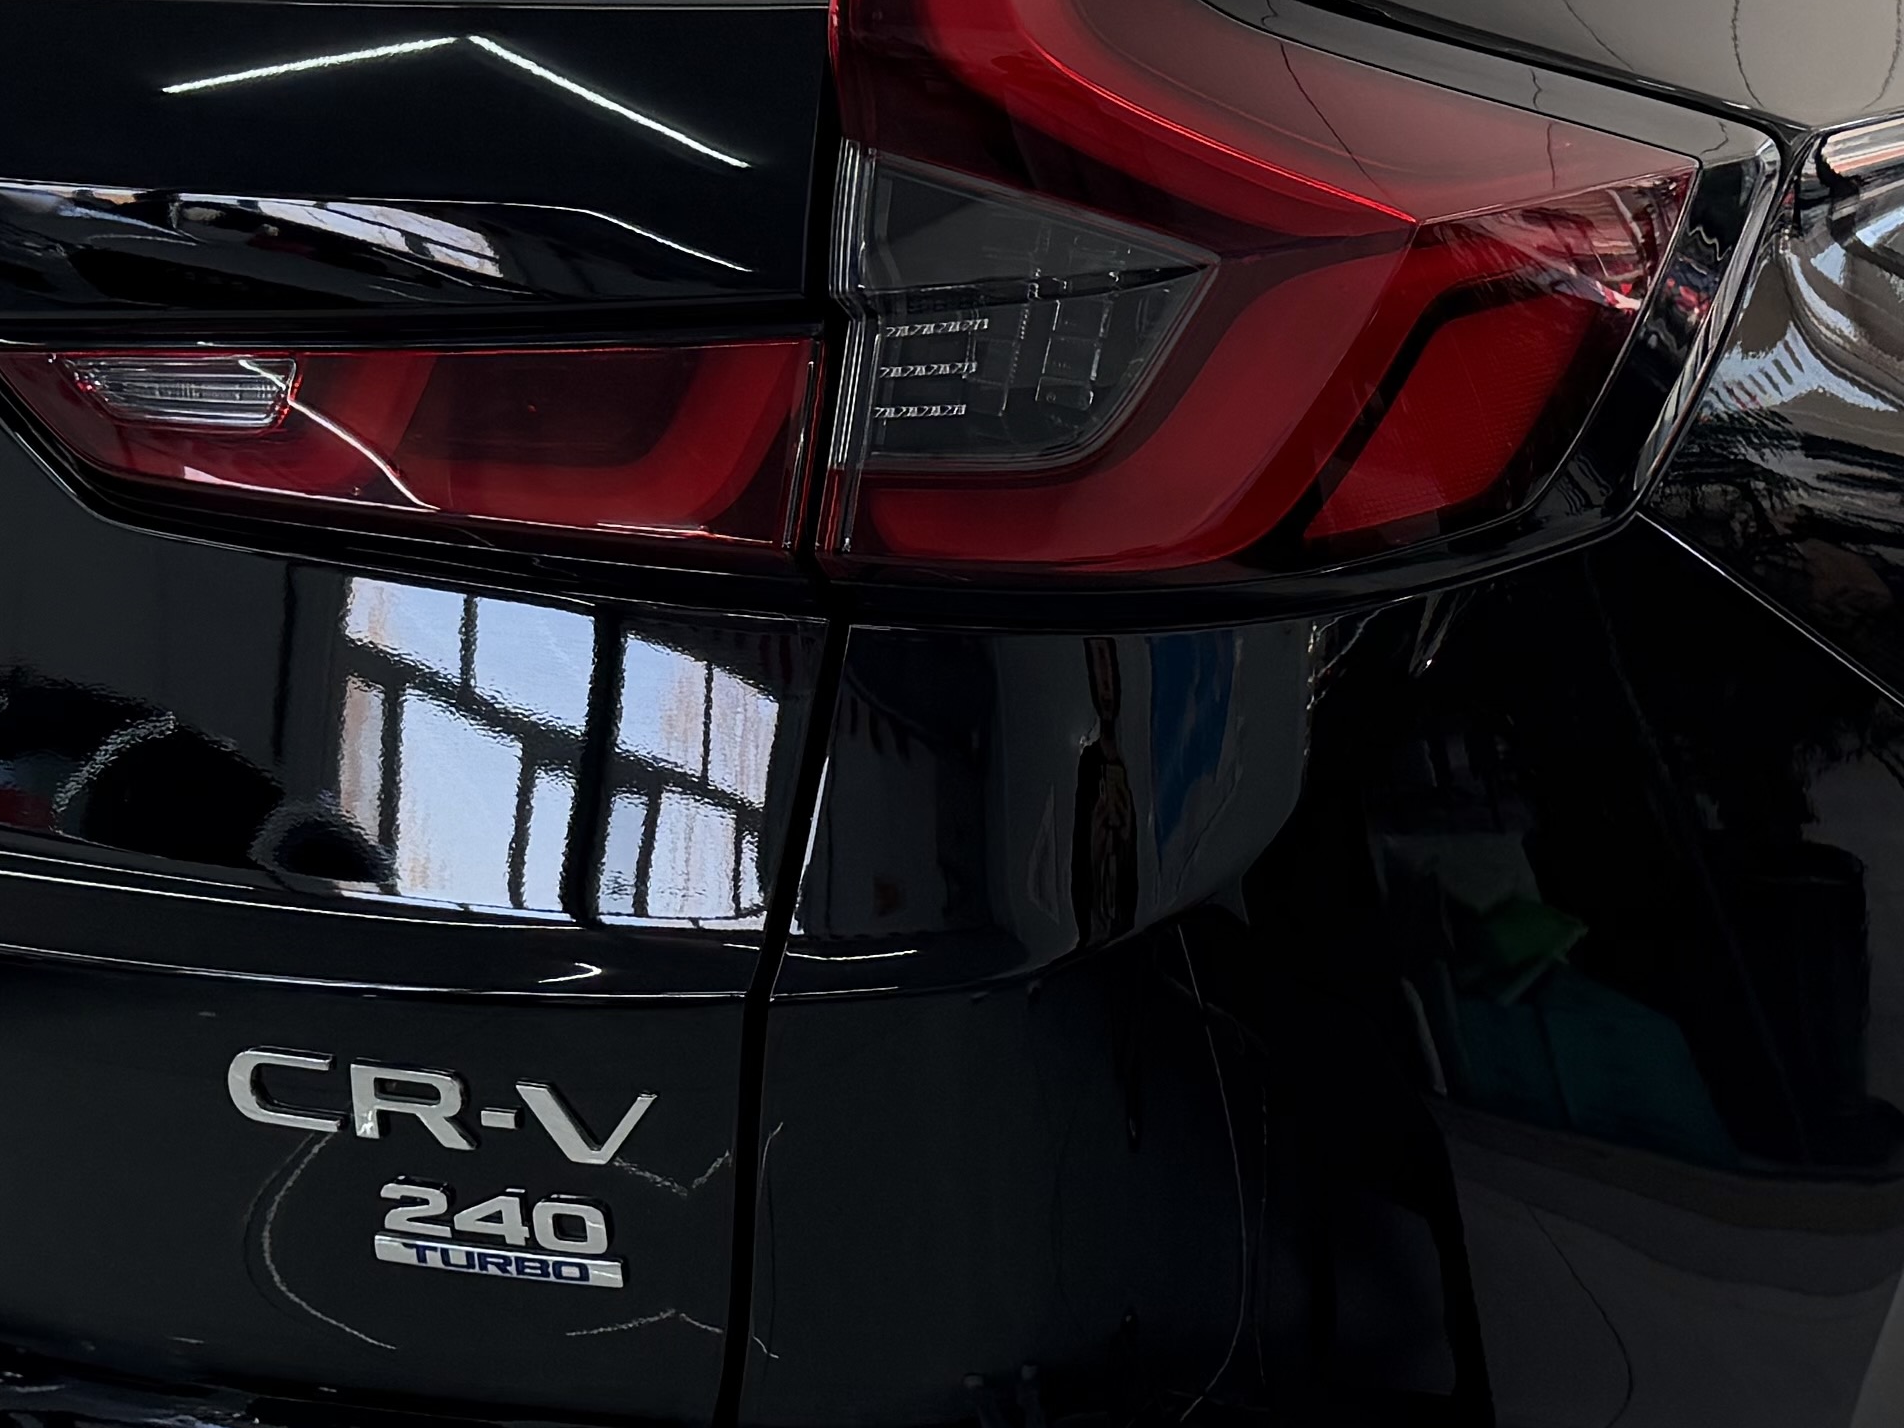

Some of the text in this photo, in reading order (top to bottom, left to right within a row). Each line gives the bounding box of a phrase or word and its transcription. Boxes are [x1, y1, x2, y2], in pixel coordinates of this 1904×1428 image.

[227, 1045, 659, 1165] CR-V
[379, 1176, 610, 1254] 240
[409, 1241, 591, 1283] TURBO
